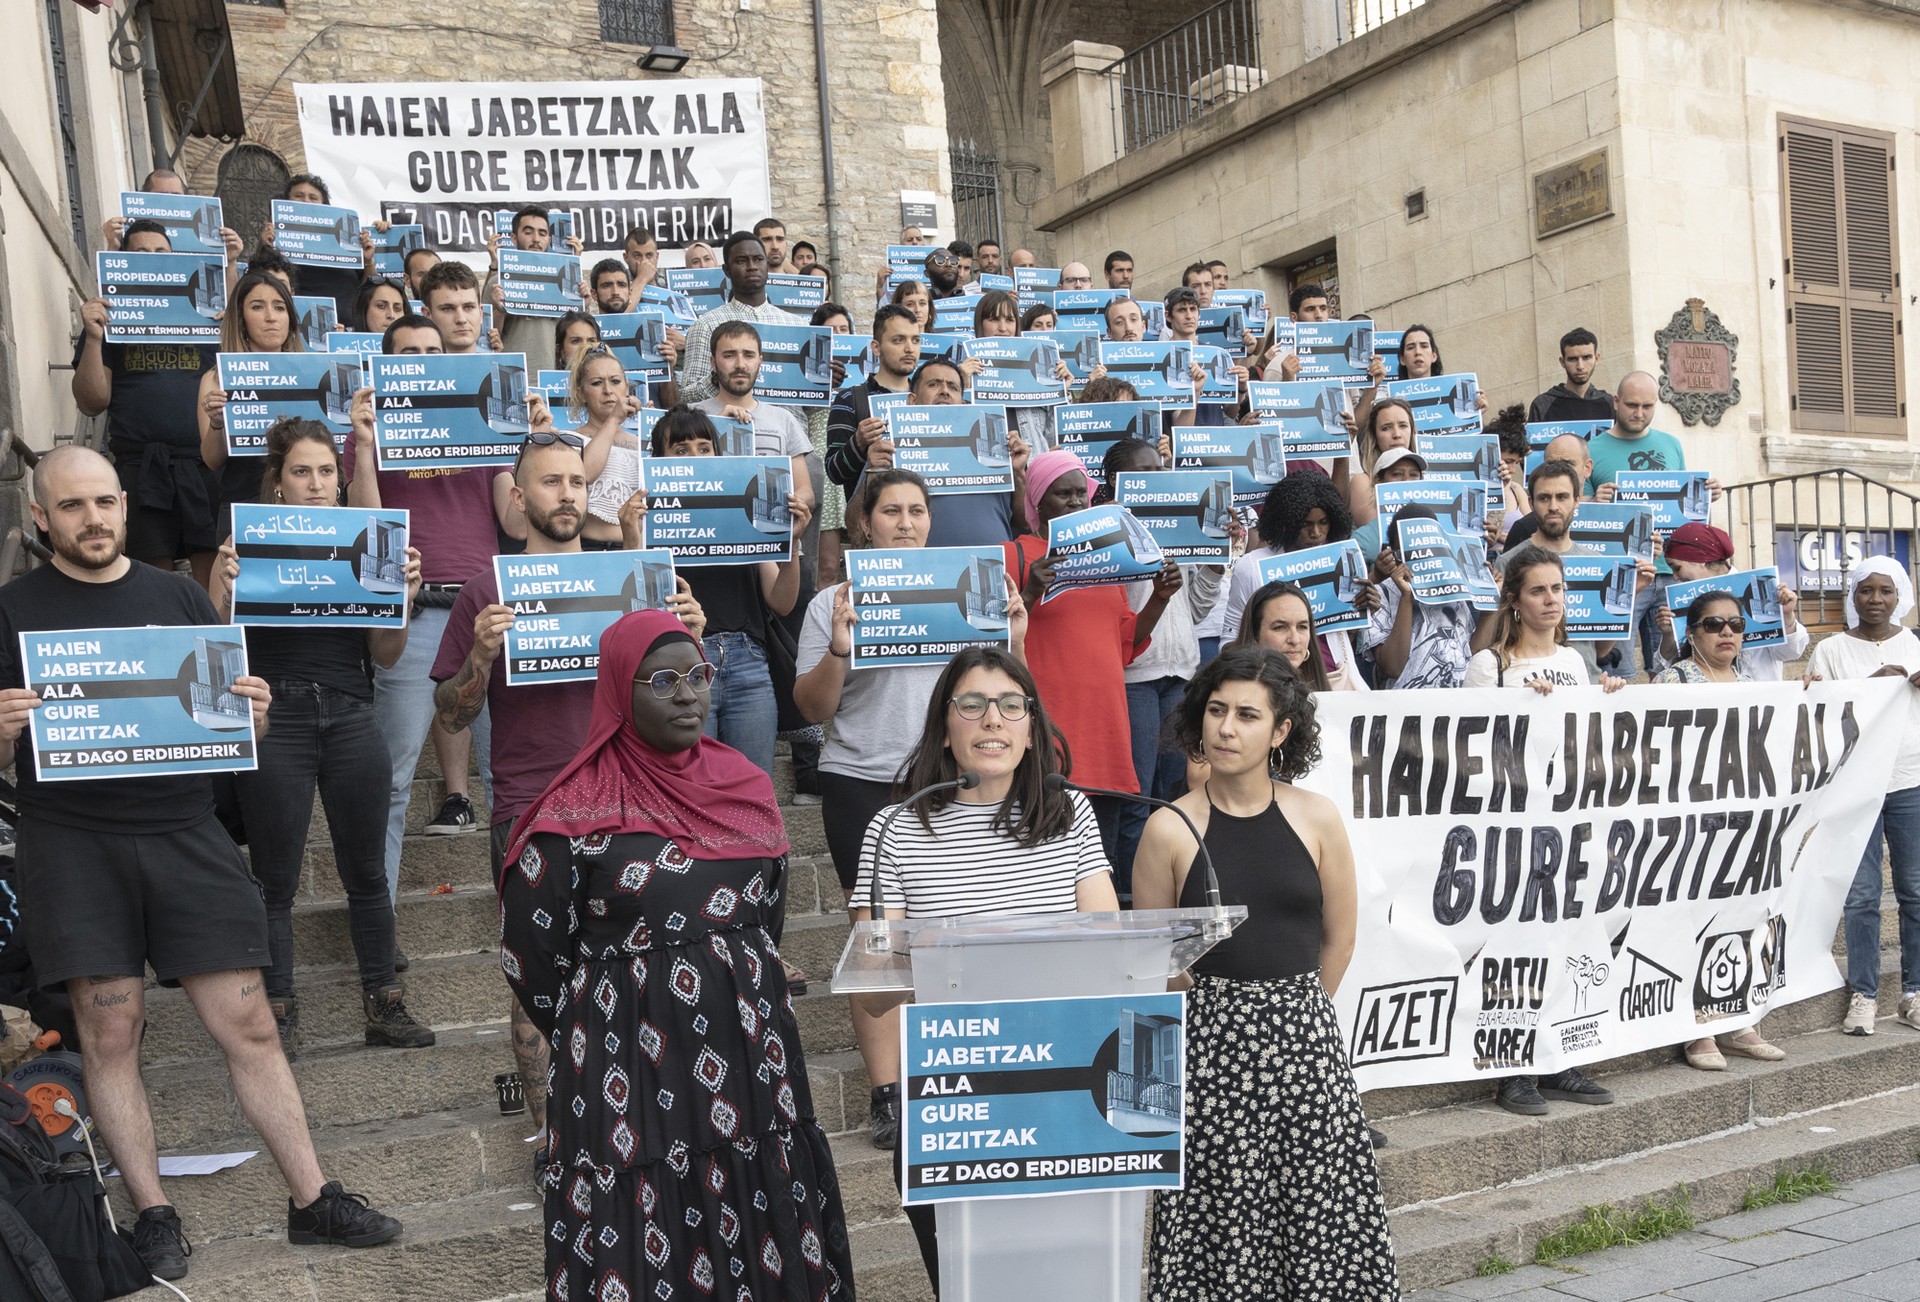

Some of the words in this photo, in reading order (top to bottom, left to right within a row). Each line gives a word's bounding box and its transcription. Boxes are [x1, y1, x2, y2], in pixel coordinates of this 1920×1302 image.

[328, 94, 451, 137] HAIEN
[468, 95, 660, 138] JABETZAK
[673, 92, 746, 134] ALA
[408, 149, 508, 193] GURE
[525, 146, 700, 192] BIZITZAK
[126, 198, 144, 206] SUS
[128, 207, 191, 218] PROPIEDADES
[278, 214, 334, 225] PROPIEDADES
[435, 210, 509, 246] DAG
[278, 232, 321, 241] NUESTRAS
[279, 240, 304, 249] VIDAS
[105, 259, 128, 268] SUS
[504, 264, 557, 273] PROPIEDADES
[106, 272, 187, 283] PROPIEDADES
[108, 285, 116, 294] O
[504, 282, 544, 290] NUESTRAS
[673, 280, 709, 288] JABETZAK
[109, 298, 169, 308] NUESTRAS
[1059, 294, 1098, 307] ممتلكاتهم
[111, 310, 144, 320] VIDAS
[1072, 317, 1098, 328] حياتنا
[112, 326, 125, 334] NO
[128, 326, 146, 335] HAY
[148, 324, 189, 335] TÉRMINO
[191, 327, 220, 335] MEDIO
[974, 350, 1017, 358] JABETZAK
[1107, 346, 1155, 362] ممتلكاتهم
[228, 361, 269, 371] HAIEN
[381, 364, 425, 376] HAIEN
[230, 375, 298, 386] JABETZAK
[383, 380, 456, 392] JABETZAK
[977, 380, 1014, 388] BIZITZAK
[231, 390, 258, 401] ALA
[988, 392, 1009, 400] DAGO
[1011, 392, 1059, 400] ERDIBIDERIK
[1254, 388, 1280, 396] HAIEN
[383, 397, 412, 408] ALA
[232, 404, 268, 415] GURE
[1062, 410, 1093, 419] HAIEN
[384, 412, 422, 424] GURE
[897, 412, 929, 421] HAIEN
[898, 425, 952, 434] JABETZAK
[1063, 421, 1111, 431] JABETZAK
[385, 428, 450, 440] BIZITZAK
[1063, 434, 1083, 442] ALA
[1180, 433, 1210, 442] HAIEN
[236, 437, 251, 446] EZ
[900, 438, 921, 447] ALA
[1297, 440, 1345, 451] ERDIBIDERIK
[1420, 441, 1433, 449] SUS
[387, 448, 403, 459] EZ
[406, 447, 442, 458] DAGO
[444, 444, 520, 456] ERDIBIDERIK
[900, 451, 928, 459] GURE
[1181, 445, 1232, 454] JABETZAK
[1181, 458, 1202, 466] ALA
[408, 468, 450, 479] ANTOLATU
[651, 465, 694, 477] HAIEN
[652, 480, 724, 493] JABETZAK
[946, 476, 1004, 486] ERDIBIDERIK
[1124, 480, 1146, 489] SUS
[1622, 480, 1634, 488] SA
[1638, 480, 1680, 488] MOOMEL
[1124, 493, 1198, 503] PROPIEDADES
[1384, 492, 1400, 500] SA
[1403, 490, 1453, 500] MOOMEL
[1622, 492, 1649, 500] WALA
[654, 498, 682, 509] ALA
[654, 513, 691, 525] GURE
[244, 515, 336, 542] ممتلكاتهم
[653, 527, 716, 539] BIZITZAK
[1057, 530, 1074, 542] SA
[1076, 516, 1118, 537] MOOMEL
[1407, 525, 1438, 535] HAIEN
[327, 546, 337, 561] أو
[673, 546, 706, 556] DAGO
[709, 543, 782, 555] ERDIBIDERIK
[1056, 541, 1093, 555] WALA
[1194, 547, 1222, 555] MEDIO
[1801, 531, 1862, 571] GLS
[1411, 549, 1434, 560] ALA
[858, 558, 902, 570] HAIEN
[1267, 569, 1284, 580] SA
[1286, 556, 1334, 575] MOOMEL
[1412, 560, 1443, 572] GURE
[508, 564, 559, 578] HAIEN
[277, 564, 336, 591] حياتنا
[860, 574, 934, 588] JABETZAK
[511, 579, 596, 596] JABETZAK
[1431, 586, 1459, 596] DAGO
[861, 592, 891, 604] ALA
[290, 603, 317, 617] وسط
[322, 604, 339, 617] حل
[343, 604, 368, 615] هناك
[372, 604, 395, 618] ليس
[514, 601, 547, 614] ALA
[861, 609, 901, 621] GURE
[515, 618, 560, 632] GURE
[861, 624, 928, 637] BIZITZAK
[37, 641, 101, 657] HAIEN
[518, 635, 592, 651] BIZITZAK
[861, 646, 877, 656] EZ
[880, 644, 917, 655] DAGO
[40, 660, 146, 678] JABETZAK
[518, 660, 537, 672] EZ
[541, 658, 581, 670] DAGO
[42, 684, 85, 699] ALA
[44, 705, 99, 720] GURE
[47, 724, 140, 741] BIZITZAK
[50, 753, 72, 766] EZ
[77, 750, 128, 764] DAGO
[133, 744, 240, 762] ERDIBIDERIK
[1350, 714, 1530, 818] HAIEN
[1552, 705, 1775, 813] JABETZAK
[1791, 701, 1860, 795] ALA
[1432, 822, 1593, 926] GURE
[1595, 804, 1801, 914] BIZITZAK
[1482, 957, 1548, 1010] BATU
[1702, 998, 1742, 1018] SARETXE
[921, 1017, 1000, 1038] HAIEN
[1357, 988, 1448, 1056] AZET
[921, 1043, 1053, 1068] JABETZAK
[1473, 1028, 1536, 1071] SAREA
[921, 1075, 973, 1096] ALA
[921, 1102, 990, 1124] GURE
[922, 1127, 1038, 1152] BIZITZAK
[922, 1166, 949, 1184] EZ
[956, 1162, 1019, 1181] DAGO
[1026, 1154, 1163, 1178] ERDIBIDERIK
